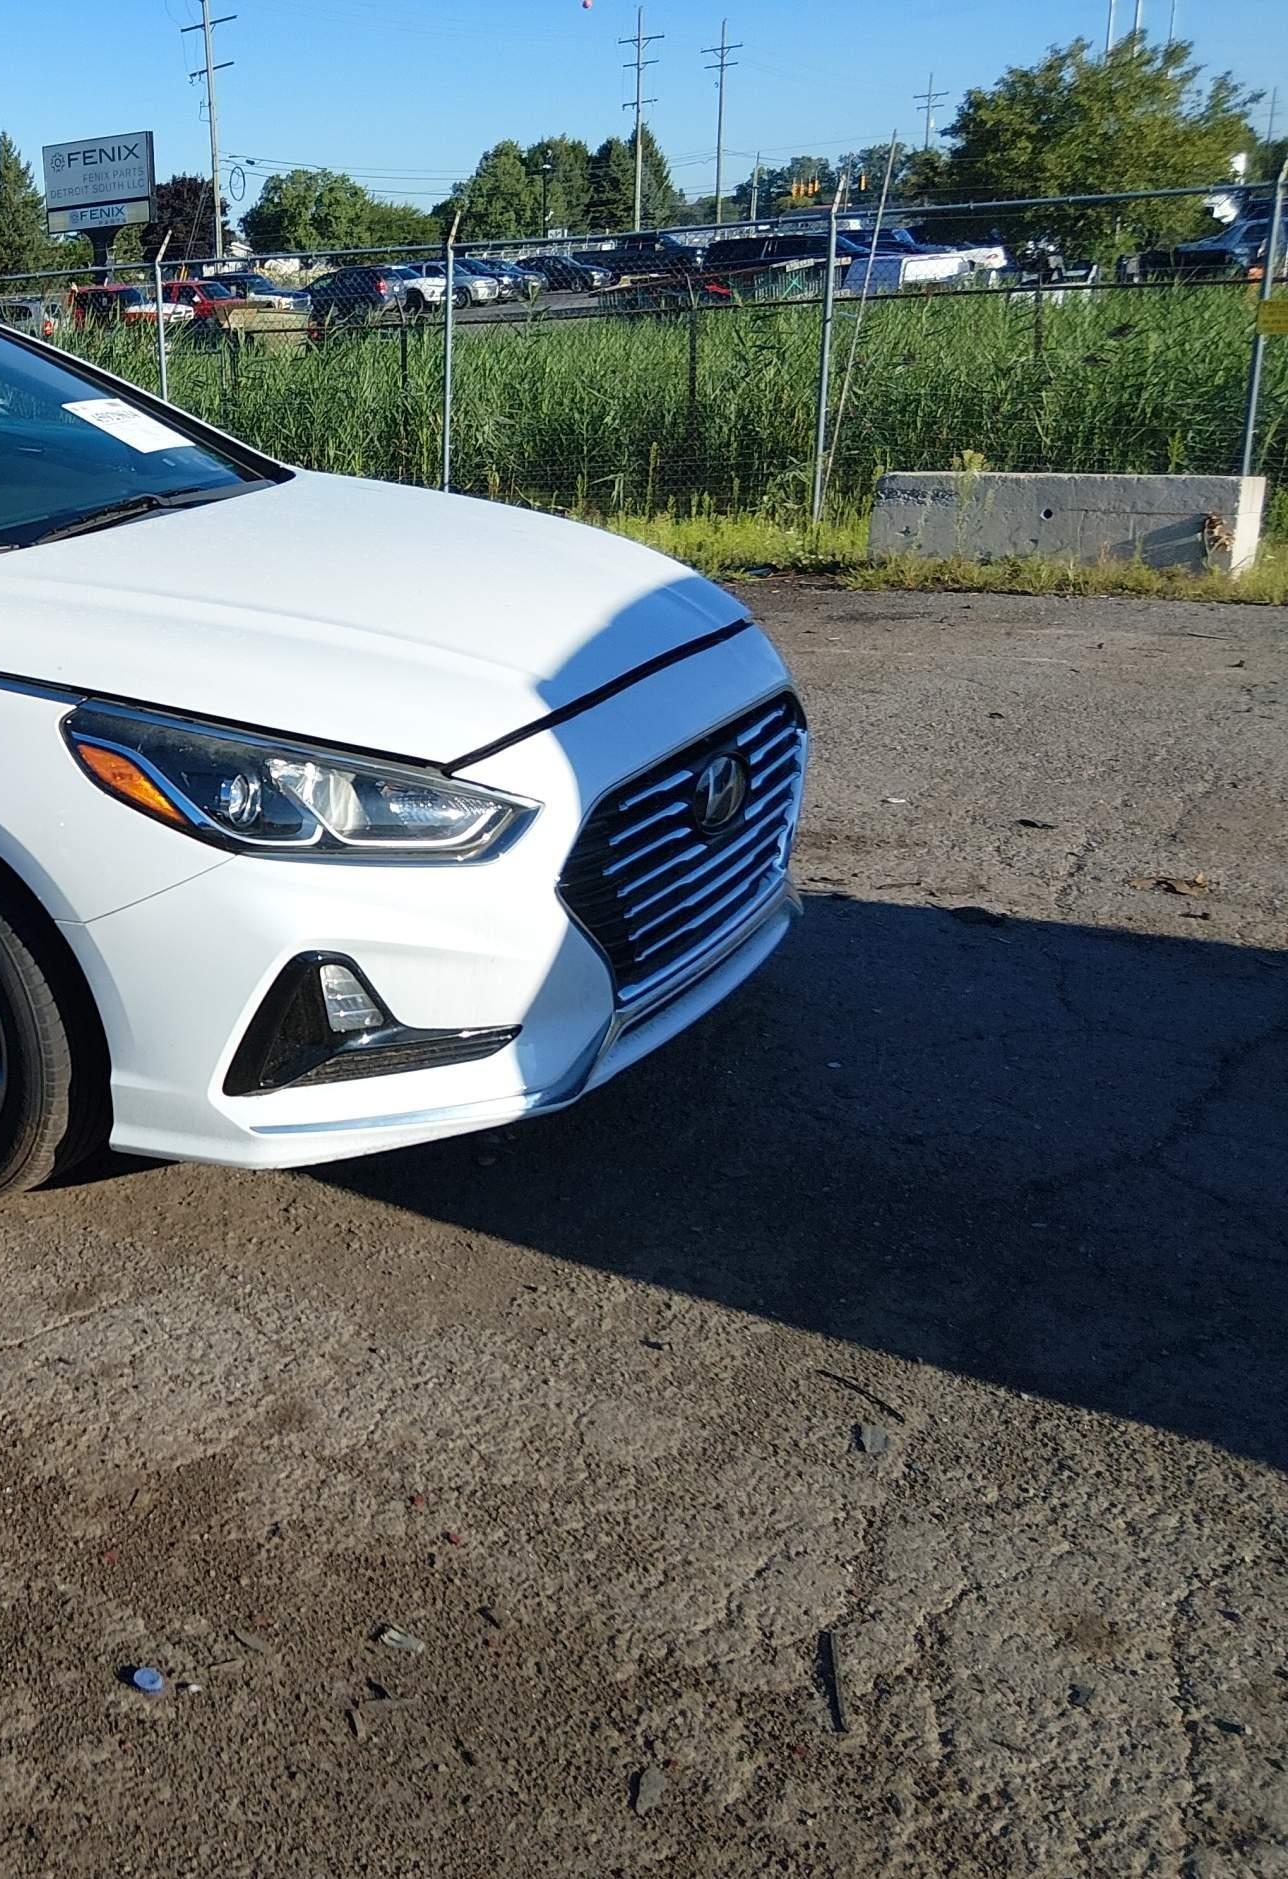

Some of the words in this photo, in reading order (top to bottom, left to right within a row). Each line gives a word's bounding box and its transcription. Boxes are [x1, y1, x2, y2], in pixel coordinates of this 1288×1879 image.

[67, 143, 140, 168] FENIX
[83, 171, 110, 184] FENIX
[113, 166, 144, 178] PARTS
[50, 185, 88, 200] DETROIT
[92, 181, 124, 193] SOUTH
[127, 178, 145, 190] LLC
[80, 205, 125, 220] FENIX
